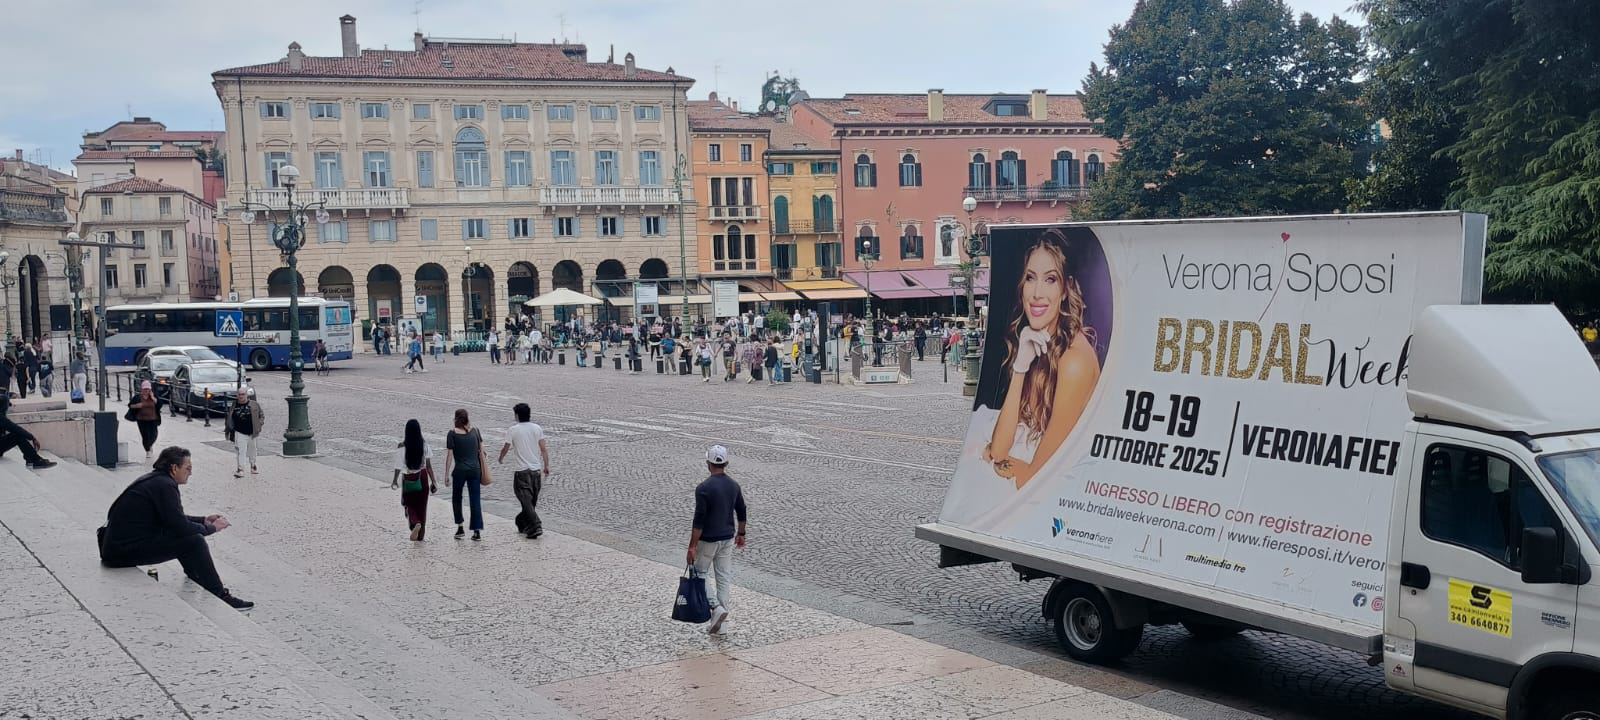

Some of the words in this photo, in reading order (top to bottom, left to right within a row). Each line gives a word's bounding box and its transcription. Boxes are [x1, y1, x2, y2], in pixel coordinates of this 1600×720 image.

[1162, 253, 1273, 291] Verona
[1286, 252, 1395, 302] Sposi
[1153, 317, 1323, 386] BRIDAL
[1122, 389, 1201, 438] 18-19
[1090, 433, 1169, 468] OTTOBRE
[1169, 445, 1221, 476] 2025
[1058, 497, 1216, 538] www.bridalweekverona.com
[1084, 479, 1160, 506] INGRESSO
[1162, 494, 1221, 518] LIBERO
[1225, 508, 1254, 525] con
[1258, 515, 1373, 546] registrazione
[1066, 527, 1114, 545] veronafiere
[1185, 553, 1232, 571] multimedia
[1233, 563, 1247, 574] tre
[1351, 580, 1384, 592] seguici
[1450, 611, 1467, 624] 340
[1470, 617, 1510, 634] 6640877
